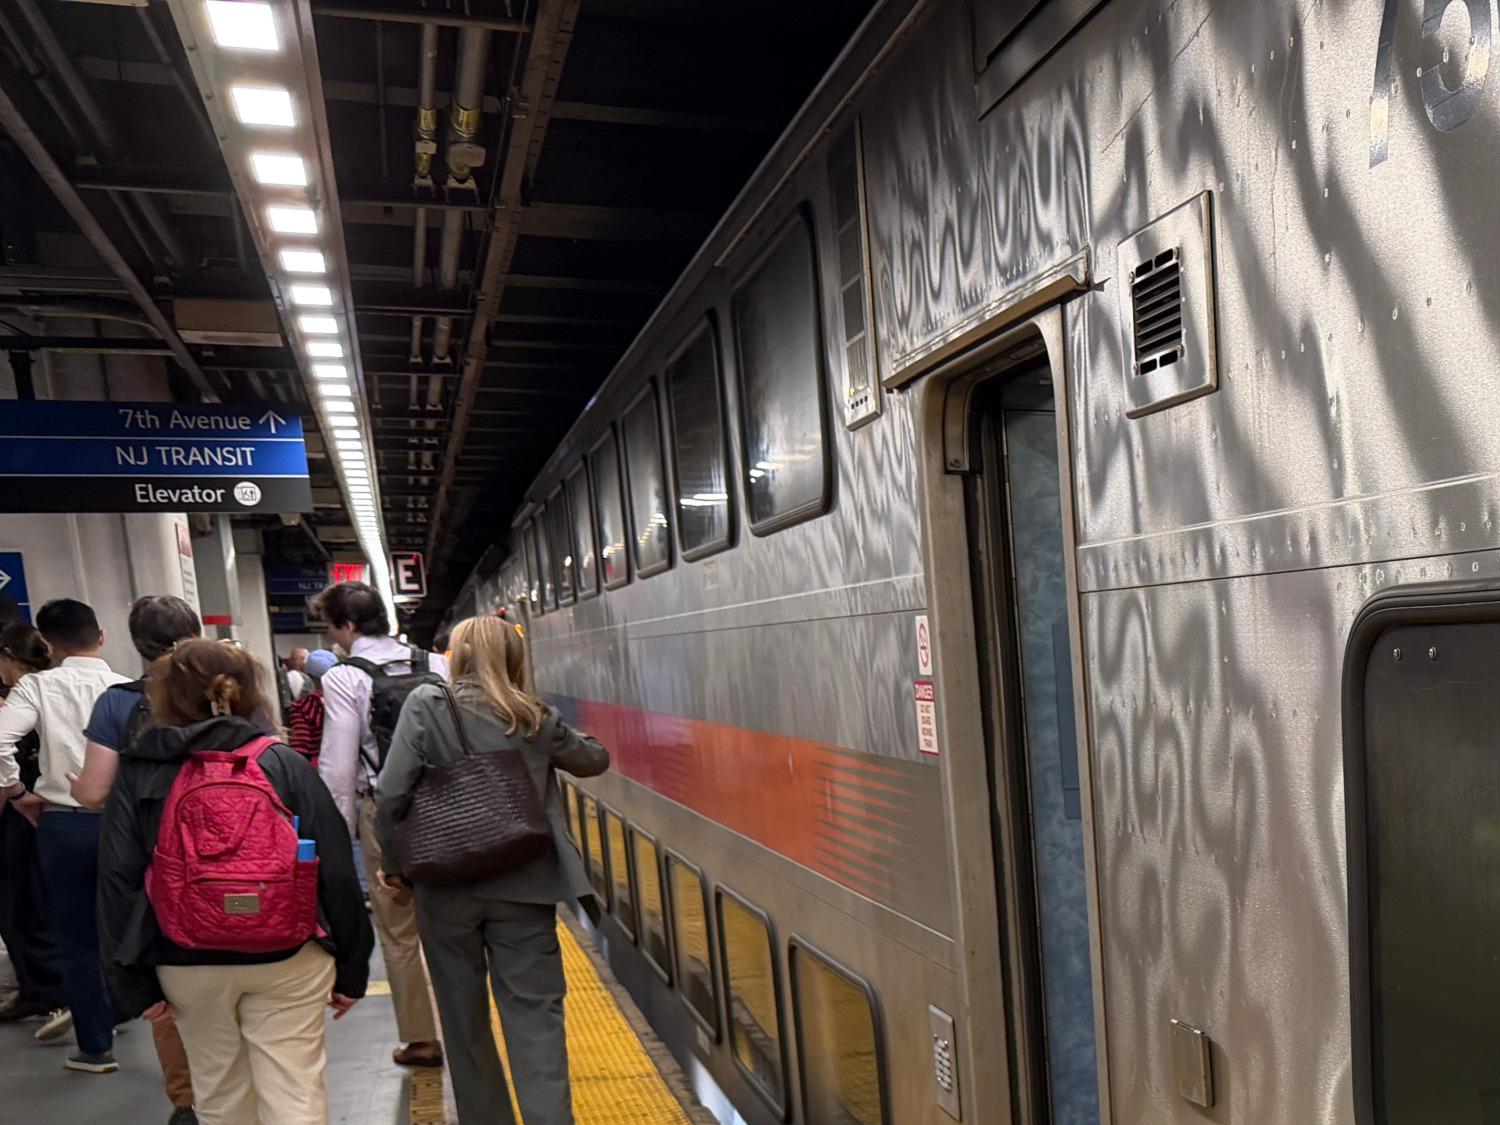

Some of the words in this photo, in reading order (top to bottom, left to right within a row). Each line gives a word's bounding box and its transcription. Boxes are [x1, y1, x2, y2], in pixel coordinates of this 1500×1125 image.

[119, 409, 160, 429] 7th
[169, 409, 251, 430] Avenue
[115, 446, 148, 466] NJ
[156, 447, 255, 466] TRANSIT
[135, 483, 226, 504] Elevator
[398, 559, 420, 591] E
